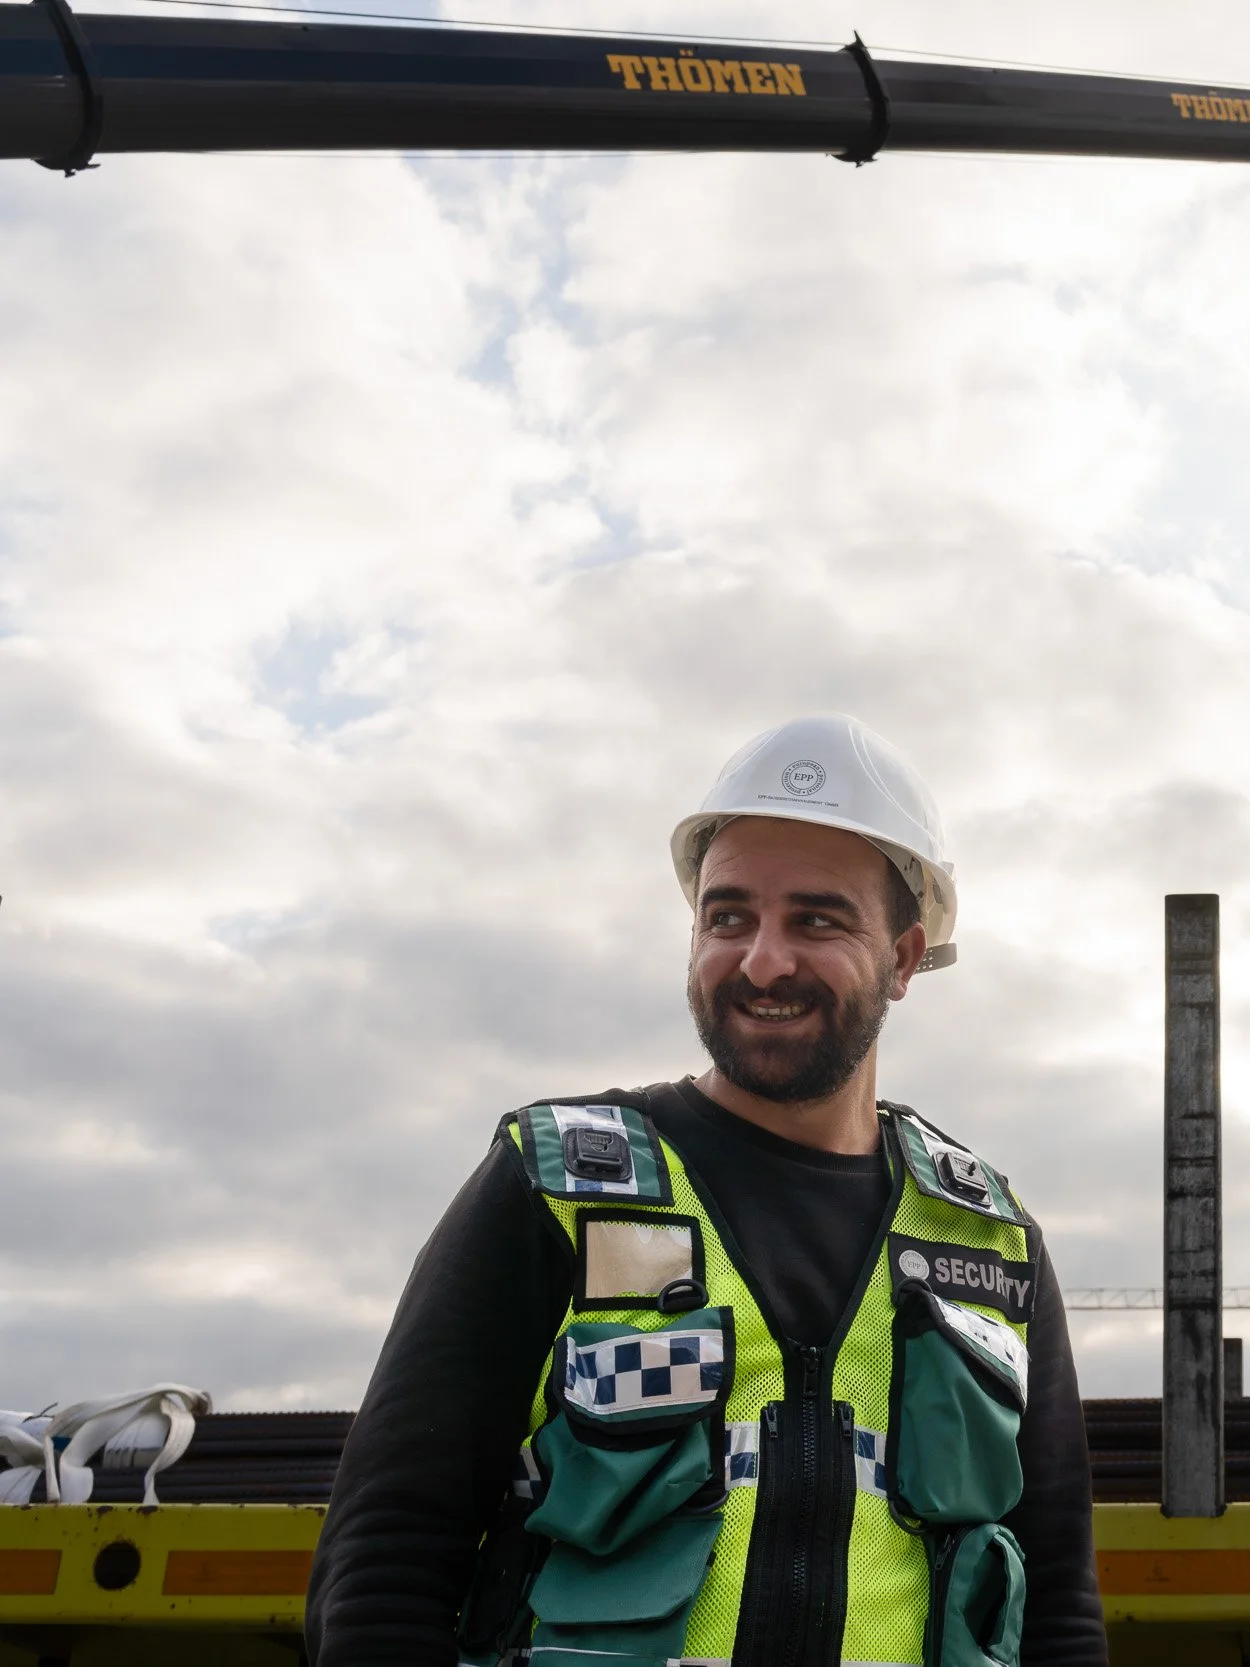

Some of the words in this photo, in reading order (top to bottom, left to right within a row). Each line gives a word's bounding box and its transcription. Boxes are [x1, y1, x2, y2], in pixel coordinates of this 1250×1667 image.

[606, 49, 807, 96] THÖMEN
[794, 773, 814, 782] EPP
[934, 1257, 1031, 1308] SECURTY
